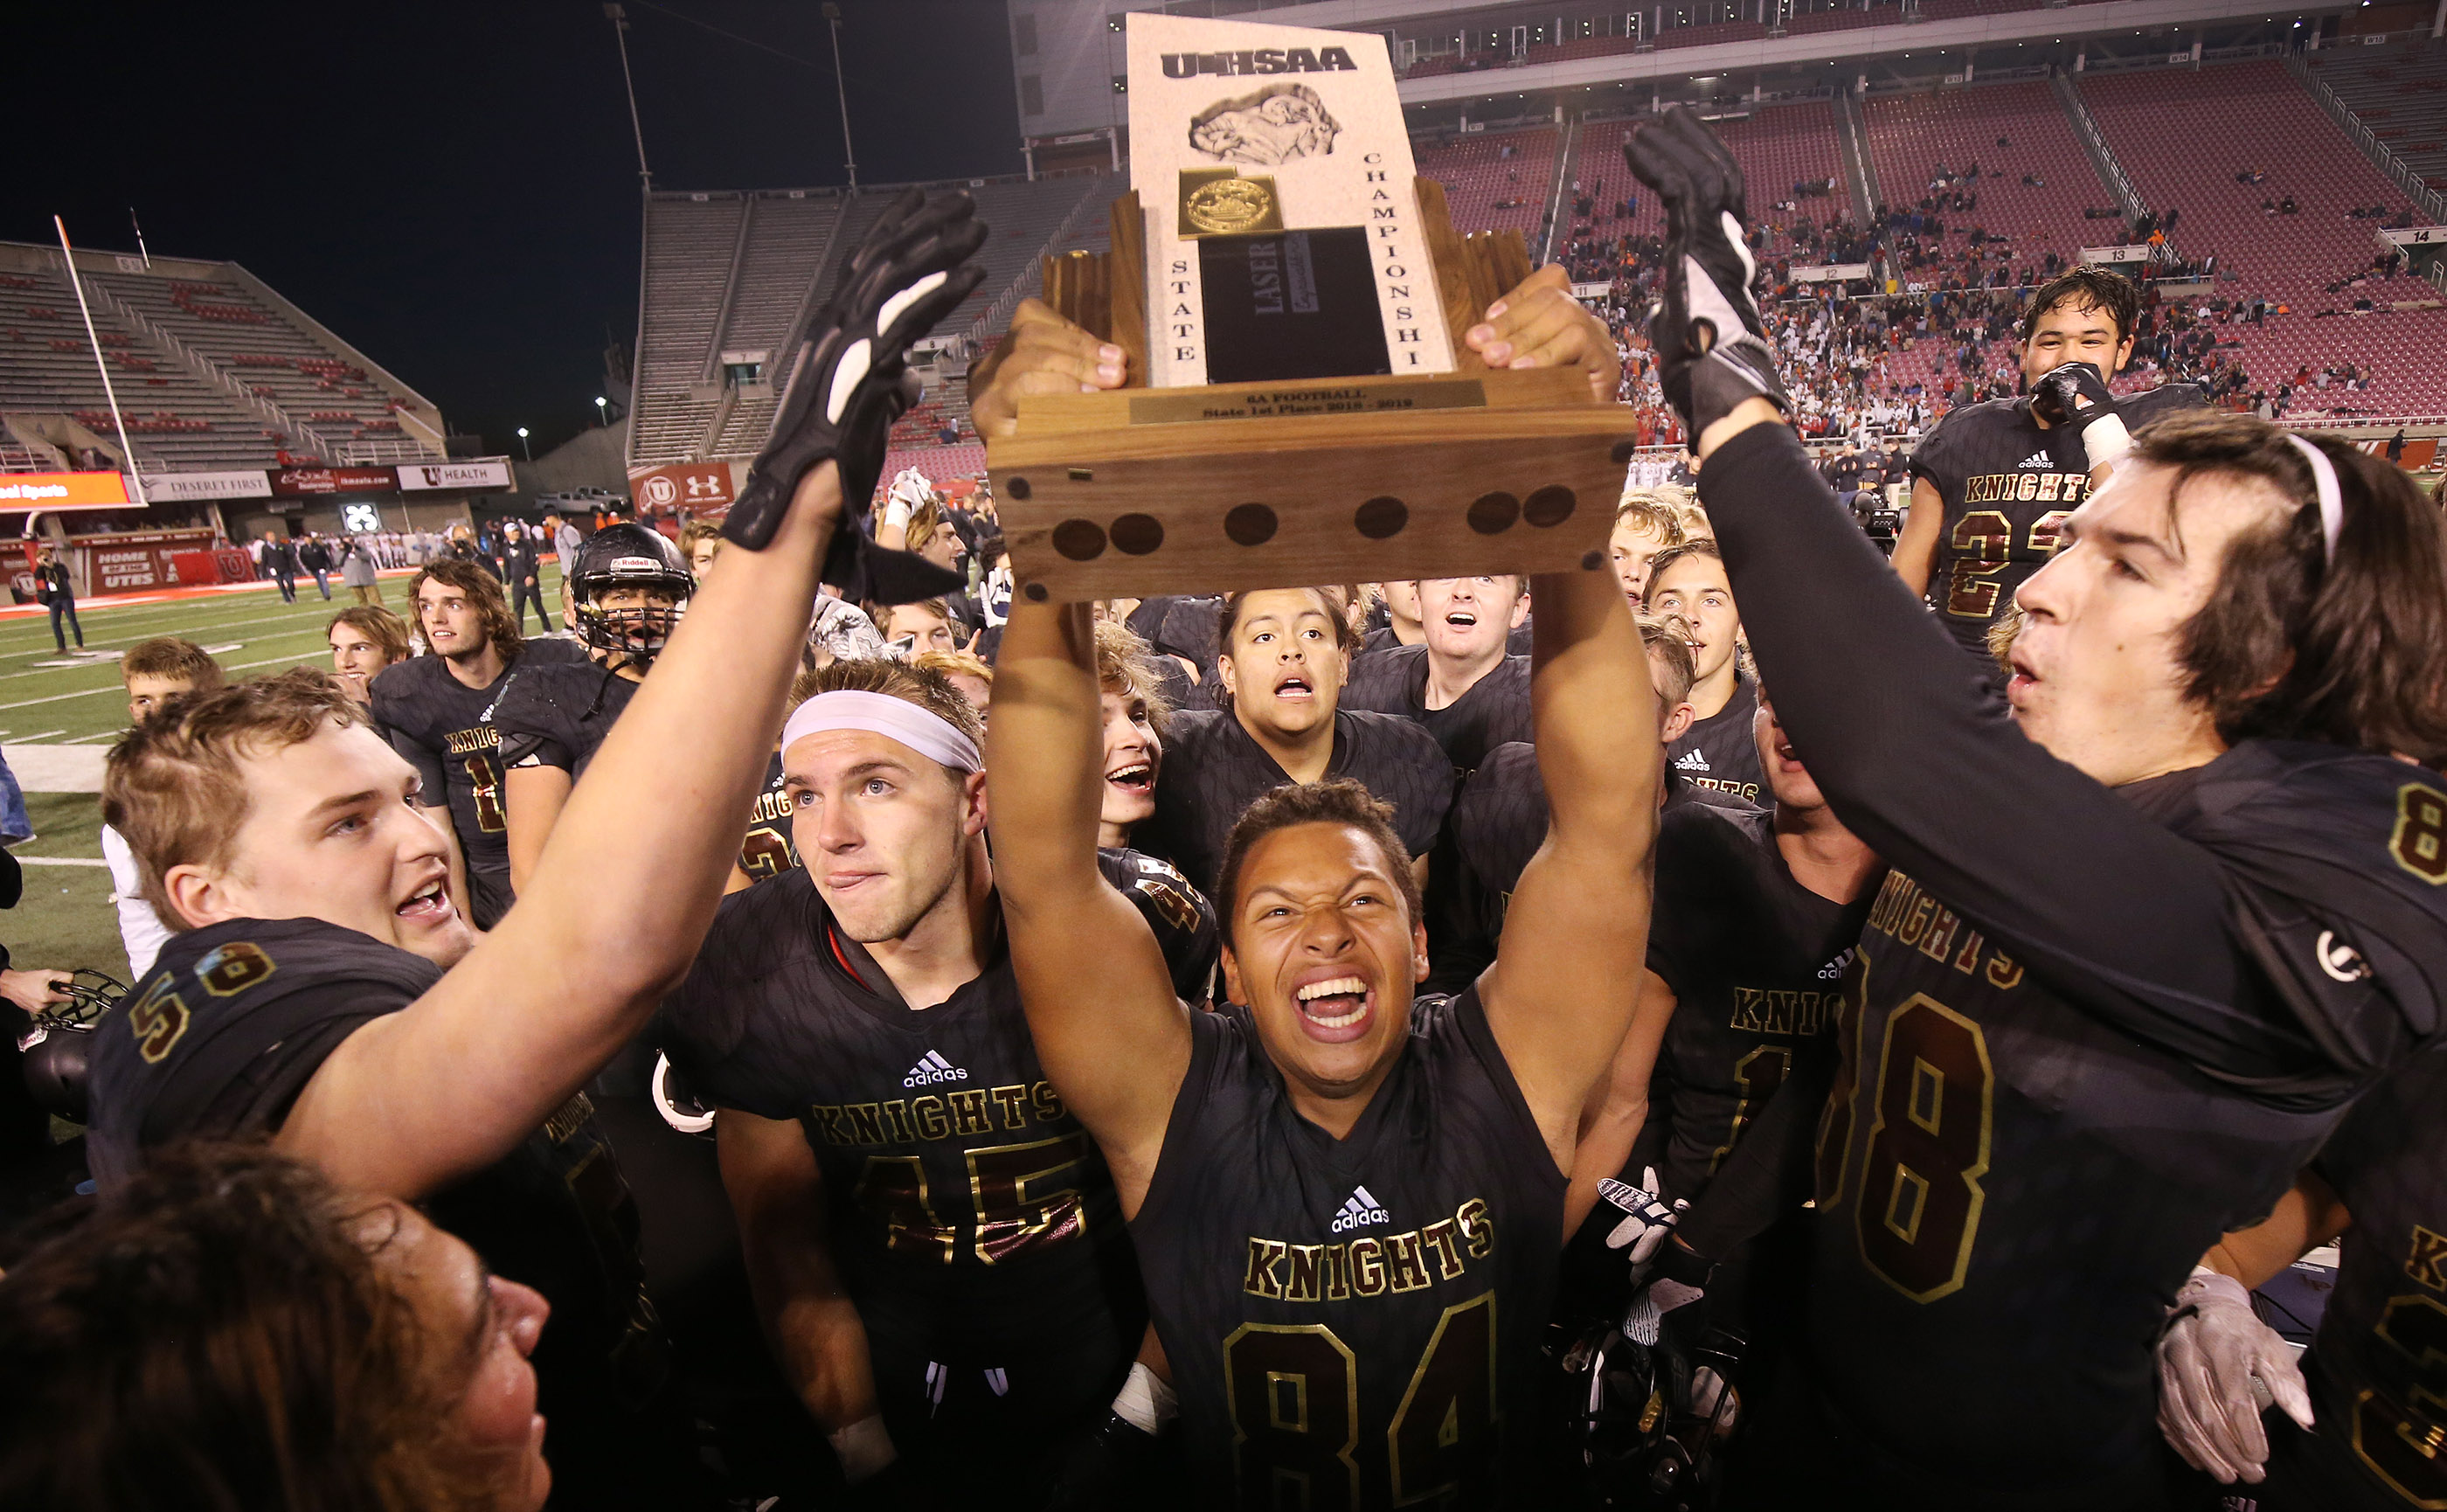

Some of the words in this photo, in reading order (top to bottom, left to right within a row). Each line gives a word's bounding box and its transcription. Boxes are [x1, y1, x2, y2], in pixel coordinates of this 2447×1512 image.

[1161, 45, 1357, 79] UHSAA
[2414, 231, 2430, 243] 14
[1362, 152, 1422, 365] CHAMPIONSHI
[2111, 250, 2125, 261] 13
[1249, 241, 1283, 316] LASER
[1826, 268, 1838, 280] 12
[1577, 286, 1587, 296] 11
[1171, 260, 1196, 361] STATE
[1272, 389, 1368, 403] FOOTBALL
[1203, 408, 1245, 418] State
[1278, 402, 1323, 414] Place
[2018, 459, 2055, 469] adidas
[445, 469, 487, 480] HEALTH
[98, 551, 147, 564] HOME
[105, 573, 154, 587] UTES
[444, 726, 500, 753] KNIG
[1674, 760, 1710, 772] adidas
[903, 1066, 967, 1088] adidas
[813, 1080, 1068, 1147] KNIGHTS
[1331, 1207, 1389, 1234] adidas
[1244, 1197, 1494, 1302] KNIGHTS
[1224, 1288, 1503, 1512] 84
